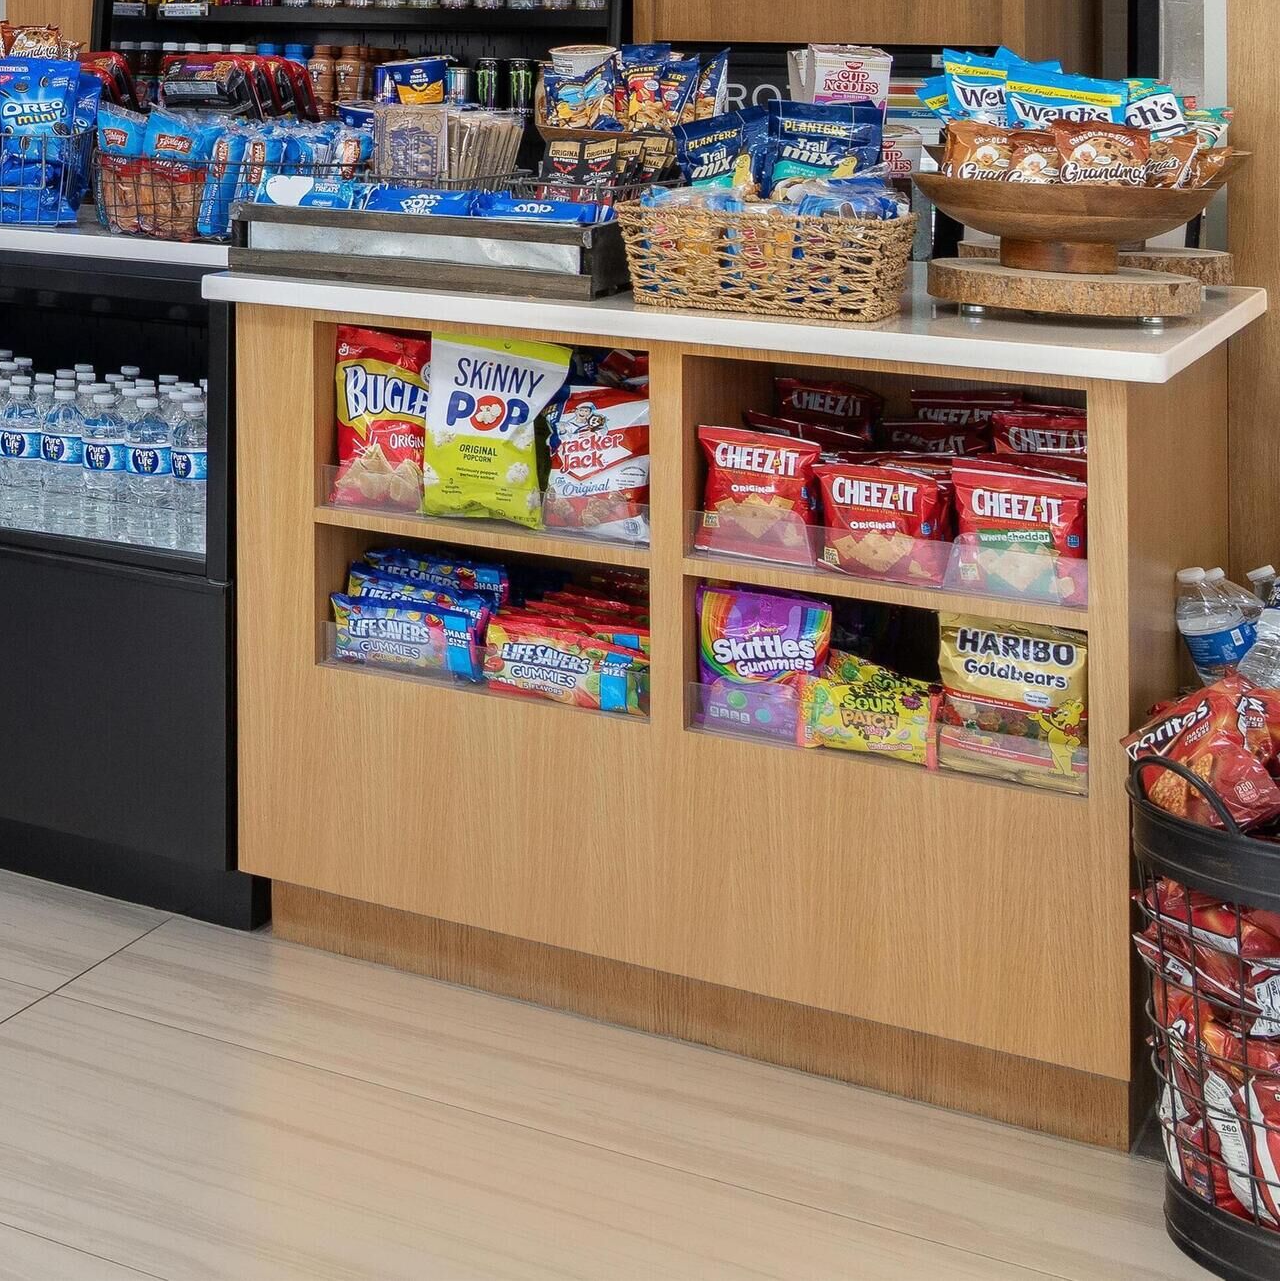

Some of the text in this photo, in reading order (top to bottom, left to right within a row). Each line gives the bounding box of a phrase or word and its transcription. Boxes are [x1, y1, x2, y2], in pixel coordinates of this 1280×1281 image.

[621, 66, 659, 76] PLANTERS
[669, 73, 687, 81] TERS
[838, 70, 869, 81] CUP
[824, 79, 878, 94] NOODLES
[1034, 88, 1053, 96] Fruit
[3, 101, 64, 117] OREO
[1017, 102, 1108, 124] Welch's
[1125, 100, 1177, 127] ch's
[18, 111, 57, 125] mini
[784, 121, 848, 136] PLANTERS
[688, 128, 739, 151] PLANTERS
[798, 138, 828, 153] Trail
[1114, 135, 1135, 147] CHIP
[552, 149, 578, 157] ORIGINA
[587, 147, 613, 157] ORIGINAL
[701, 148, 727, 164] Trail
[782, 146, 837, 166] mix
[883, 150, 901, 160] UP
[691, 157, 732, 178] mix
[314, 186, 339, 194] TREATS
[343, 364, 429, 421] BUGLE
[446, 390, 530, 432] POP
[3, 431, 22, 442] Pure
[5, 439, 20, 448] Life
[44, 437, 61, 447] Pure
[390, 433, 425, 449] ORIGIN
[46, 445, 59, 453] Life
[135, 448, 155, 460] Pure
[459, 443, 498, 457] ORIGINAL
[138, 457, 153, 466] Life
[173, 452, 188, 464] Pure
[463, 454, 492, 463] POPCORN
[560, 453, 606, 474] Jack
[174, 461, 186, 470] Life
[562, 478, 610, 497] Original
[1008, 532, 1050, 542] cheddar
[474, 582, 504, 593] SHARE
[443, 629, 471, 641] SHARE
[360, 639, 421, 659] GUMMIES
[448, 638, 467, 649] SIZE
[713, 634, 816, 664] Skittles
[957, 627, 1075, 667] HARIBO
[602, 668, 627, 677] SIZE
[735, 657, 815, 677] Gummies
[964, 658, 1068, 690] Goldbears
[511, 665, 577, 689] GUMMIES
[523, 681, 564, 695] 5 FLAVORS
[842, 693, 897, 715] SOUR
[841, 708, 899, 730] PATCH
[1126, 698, 1210, 761] Doritos
[1185, 721, 1210, 738] NACHO
[1184, 728, 1211, 747] CHEESE
[1236, 781, 1254, 794] 260
[1221, 1124, 1238, 1134] 260
